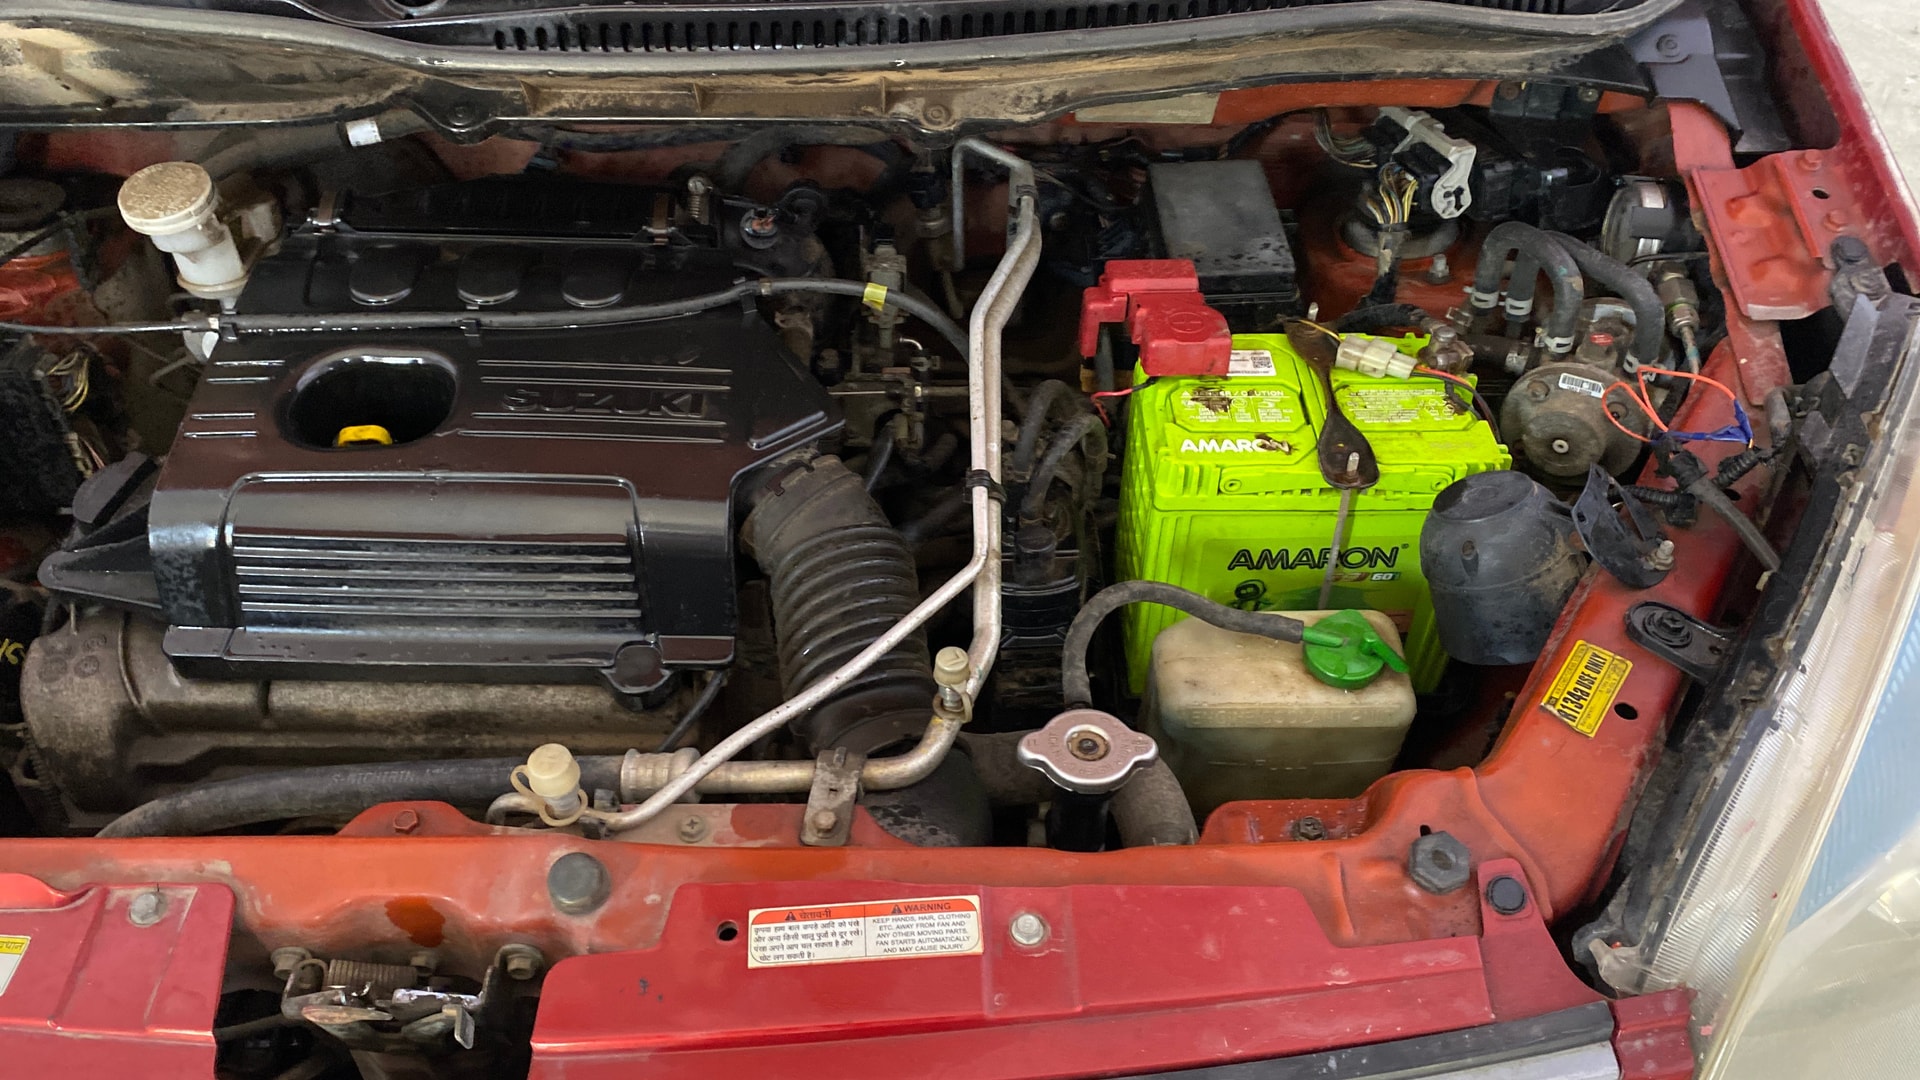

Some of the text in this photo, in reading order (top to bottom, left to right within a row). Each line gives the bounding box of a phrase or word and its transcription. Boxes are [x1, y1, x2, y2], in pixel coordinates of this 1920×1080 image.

[503, 388, 706, 418] SUZUKI
[1584, 652, 1608, 675] ONLY
[1576, 672, 1598, 690] USE
[1557, 687, 1590, 722] R134a
[904, 902, 951, 912] WARNING
[917, 936, 971, 944] AUTOMATICALLY
